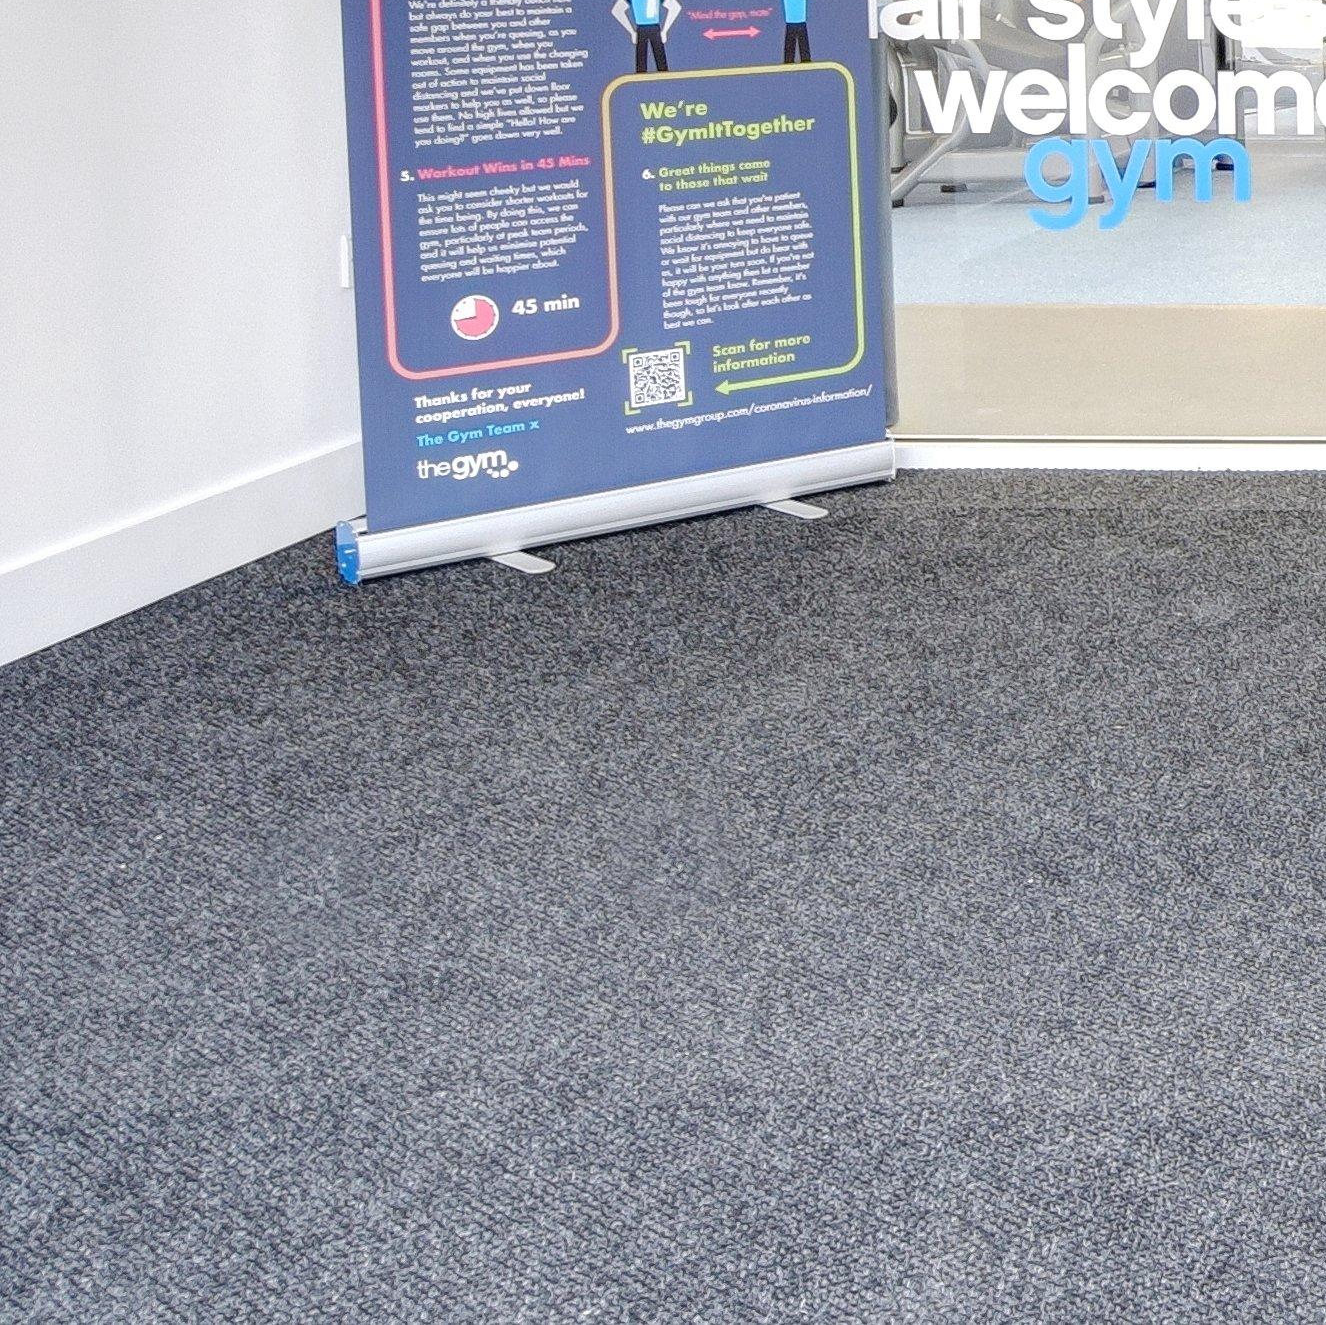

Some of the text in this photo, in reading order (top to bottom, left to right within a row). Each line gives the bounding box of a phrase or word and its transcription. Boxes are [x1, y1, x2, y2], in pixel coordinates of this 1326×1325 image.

[640, 101, 708, 120] We're
[641, 114, 815, 147] #GymItTogether
[400, 155, 591, 182] 5. Workout Wins in 45 Mins
[642, 159, 771, 180] 6. Great things come
[659, 172, 768, 192] to those that wait
[1023, 136, 1251, 231] gym
[511, 294, 580, 316] 45 min
[712, 334, 811, 358] Scan for more
[713, 351, 796, 373] information
[414, 383, 532, 410] Thanks for your
[415, 388, 585, 424] cooperation, everyone!
[416, 420, 539, 448] The Gym Team x
